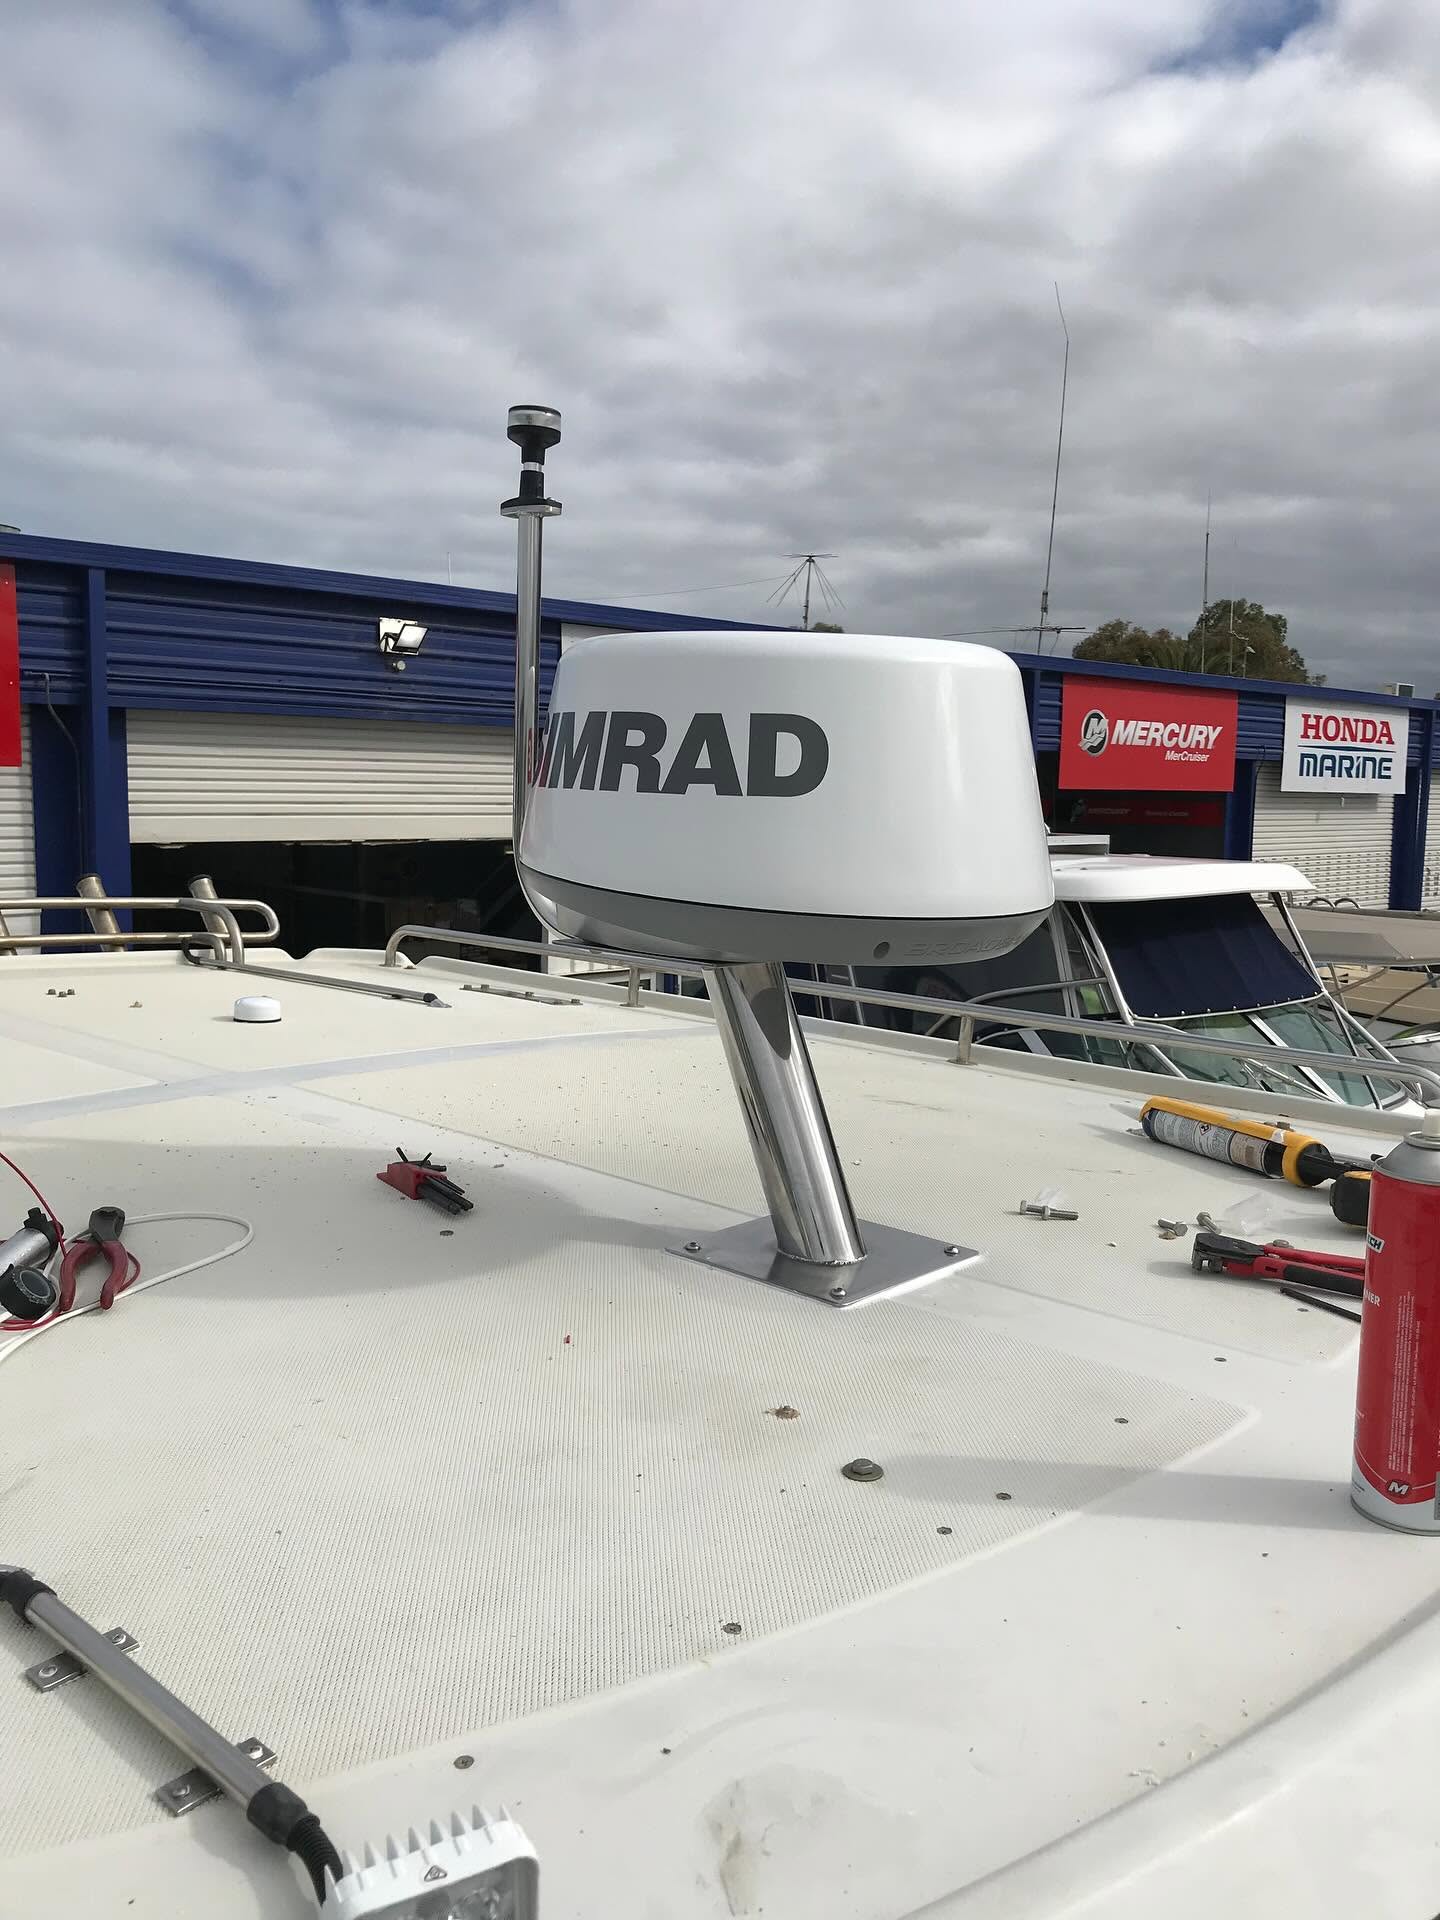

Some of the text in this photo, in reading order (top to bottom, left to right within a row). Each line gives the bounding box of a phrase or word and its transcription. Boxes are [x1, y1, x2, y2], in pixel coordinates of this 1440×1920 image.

[1111, 720, 1223, 749] MERCURY
[1300, 713, 1395, 745] HONDA
[532, 711, 829, 797] IMRAD
[1165, 751, 1210, 762] MerCruiser
[1299, 753, 1393, 779] MARINE
